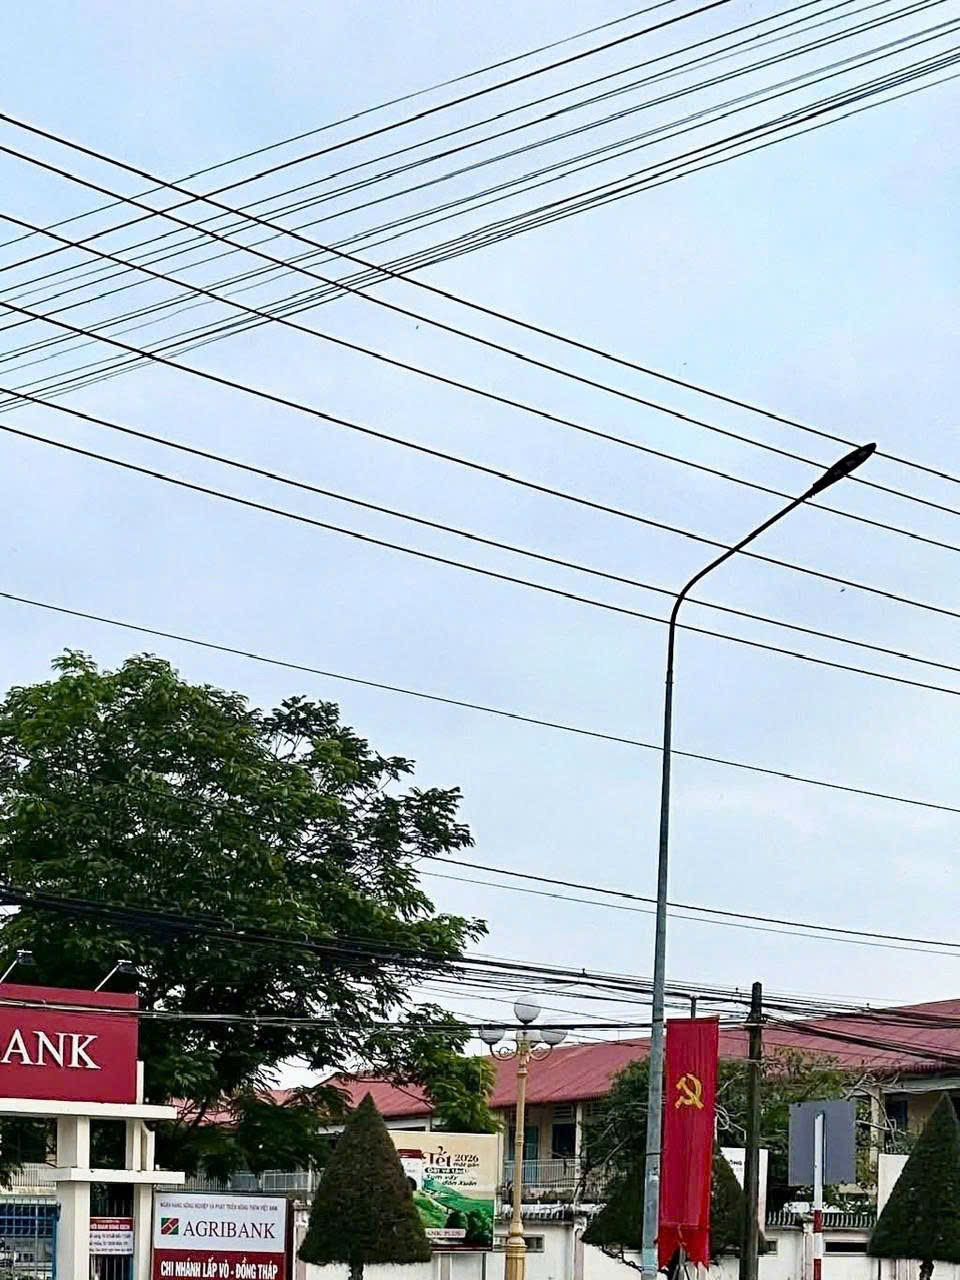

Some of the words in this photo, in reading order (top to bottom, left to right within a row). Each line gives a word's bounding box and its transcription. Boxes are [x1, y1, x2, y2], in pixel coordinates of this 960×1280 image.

[423, 1146, 451, 1167] Tết
[454, 1153, 479, 1162] 2026
[183, 1220, 276, 1239] AGRIBANK
[161, 1260, 174, 1276] CHI
[175, 1257, 200, 1277] NHÁNH
[202, 1255, 218, 1278] LẤP
[219, 1259, 229, 1278] VÒ
[235, 1257, 257, 1279] ĐỒNG
[258, 1260, 278, 1280] THÁP
